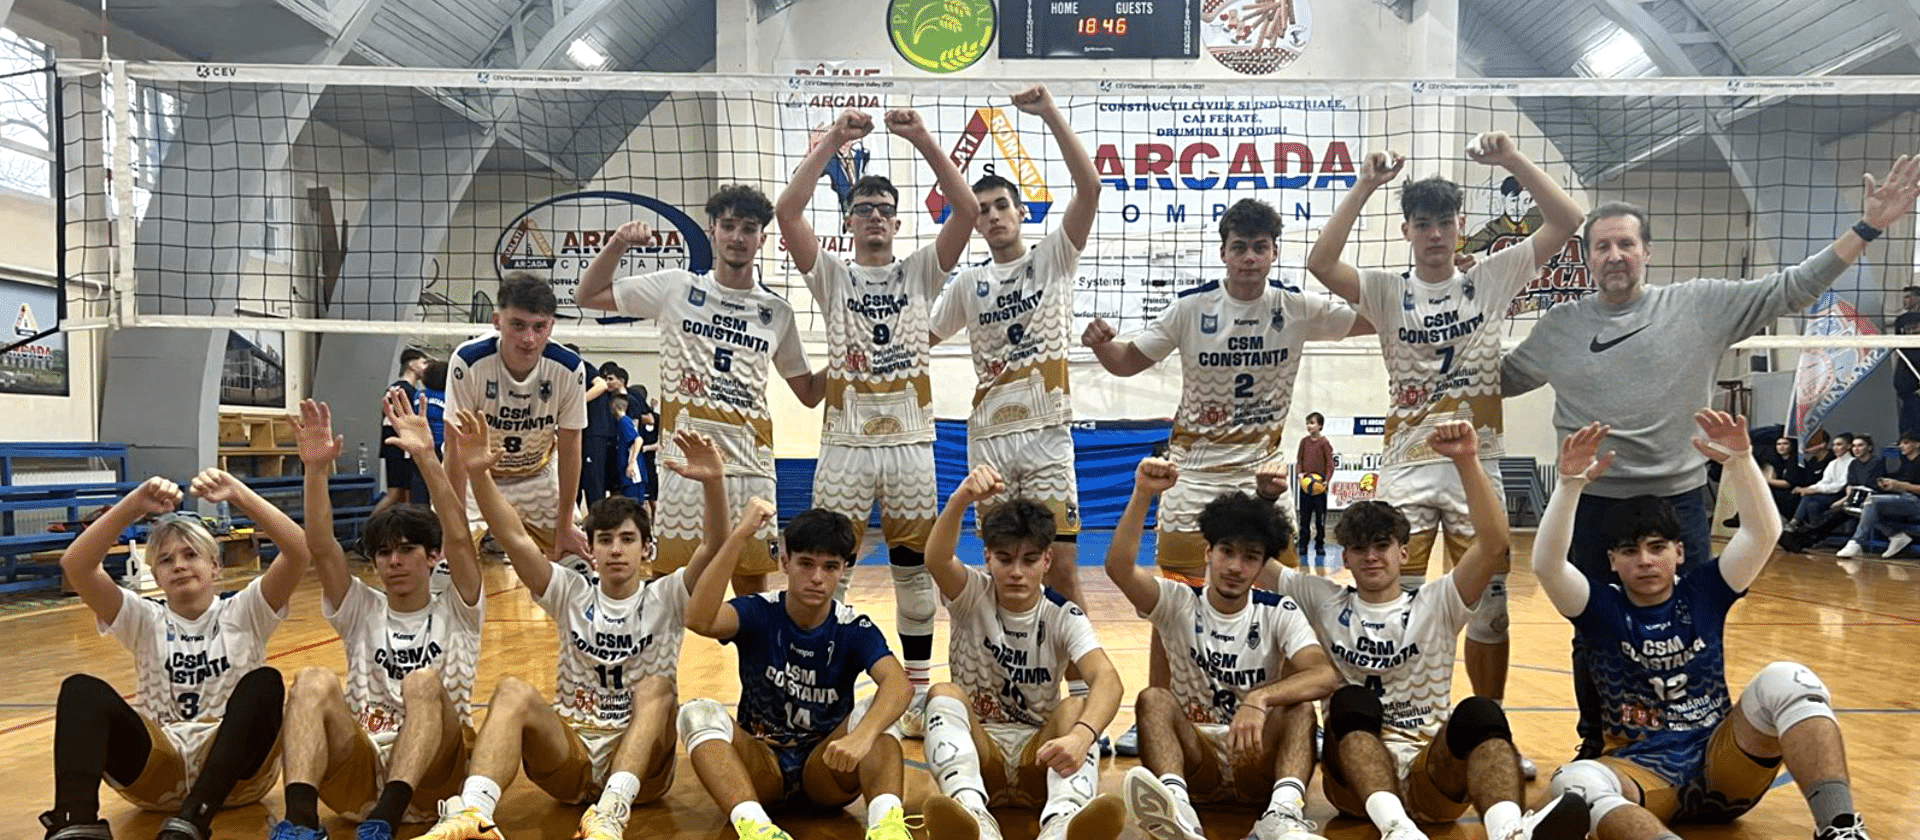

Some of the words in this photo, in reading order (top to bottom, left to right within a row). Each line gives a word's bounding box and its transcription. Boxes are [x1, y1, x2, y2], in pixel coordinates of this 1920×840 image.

[1051, 2, 1079, 14] HOME
[1115, 2, 1153, 14] GUESTS
[213, 67, 237, 77] CEV
[809, 95, 880, 107] ARCADA
[1099, 102, 1188, 113] CONSTRUCTII
[1191, 101, 1235, 111] CIVILE
[1183, 114, 1206, 124] CAI
[1156, 127, 1218, 137] DRUMURI
[1238, 126, 1288, 137] PODURI
[1094, 141, 1358, 191] ARCADA
[561, 230, 684, 254] ARDA
[560, 259, 685, 269] COPANY
[862, 293, 895, 307] CSM
[712, 314, 748, 332] CSM
[1423, 310, 1459, 328] CSM
[873, 323, 890, 345] 9
[1228, 336, 1264, 350] CSM
[714, 346, 733, 373] 5
[1435, 346, 1455, 375] 7
[1234, 373, 1254, 398] 2
[503, 436, 522, 453] 8
[595, 631, 632, 649] CSM
[1642, 635, 1685, 656] CSM
[594, 665, 624, 690] 11
[1364, 674, 1386, 698] 4
[1648, 673, 1688, 701] 12
[177, 692, 200, 720] 3
